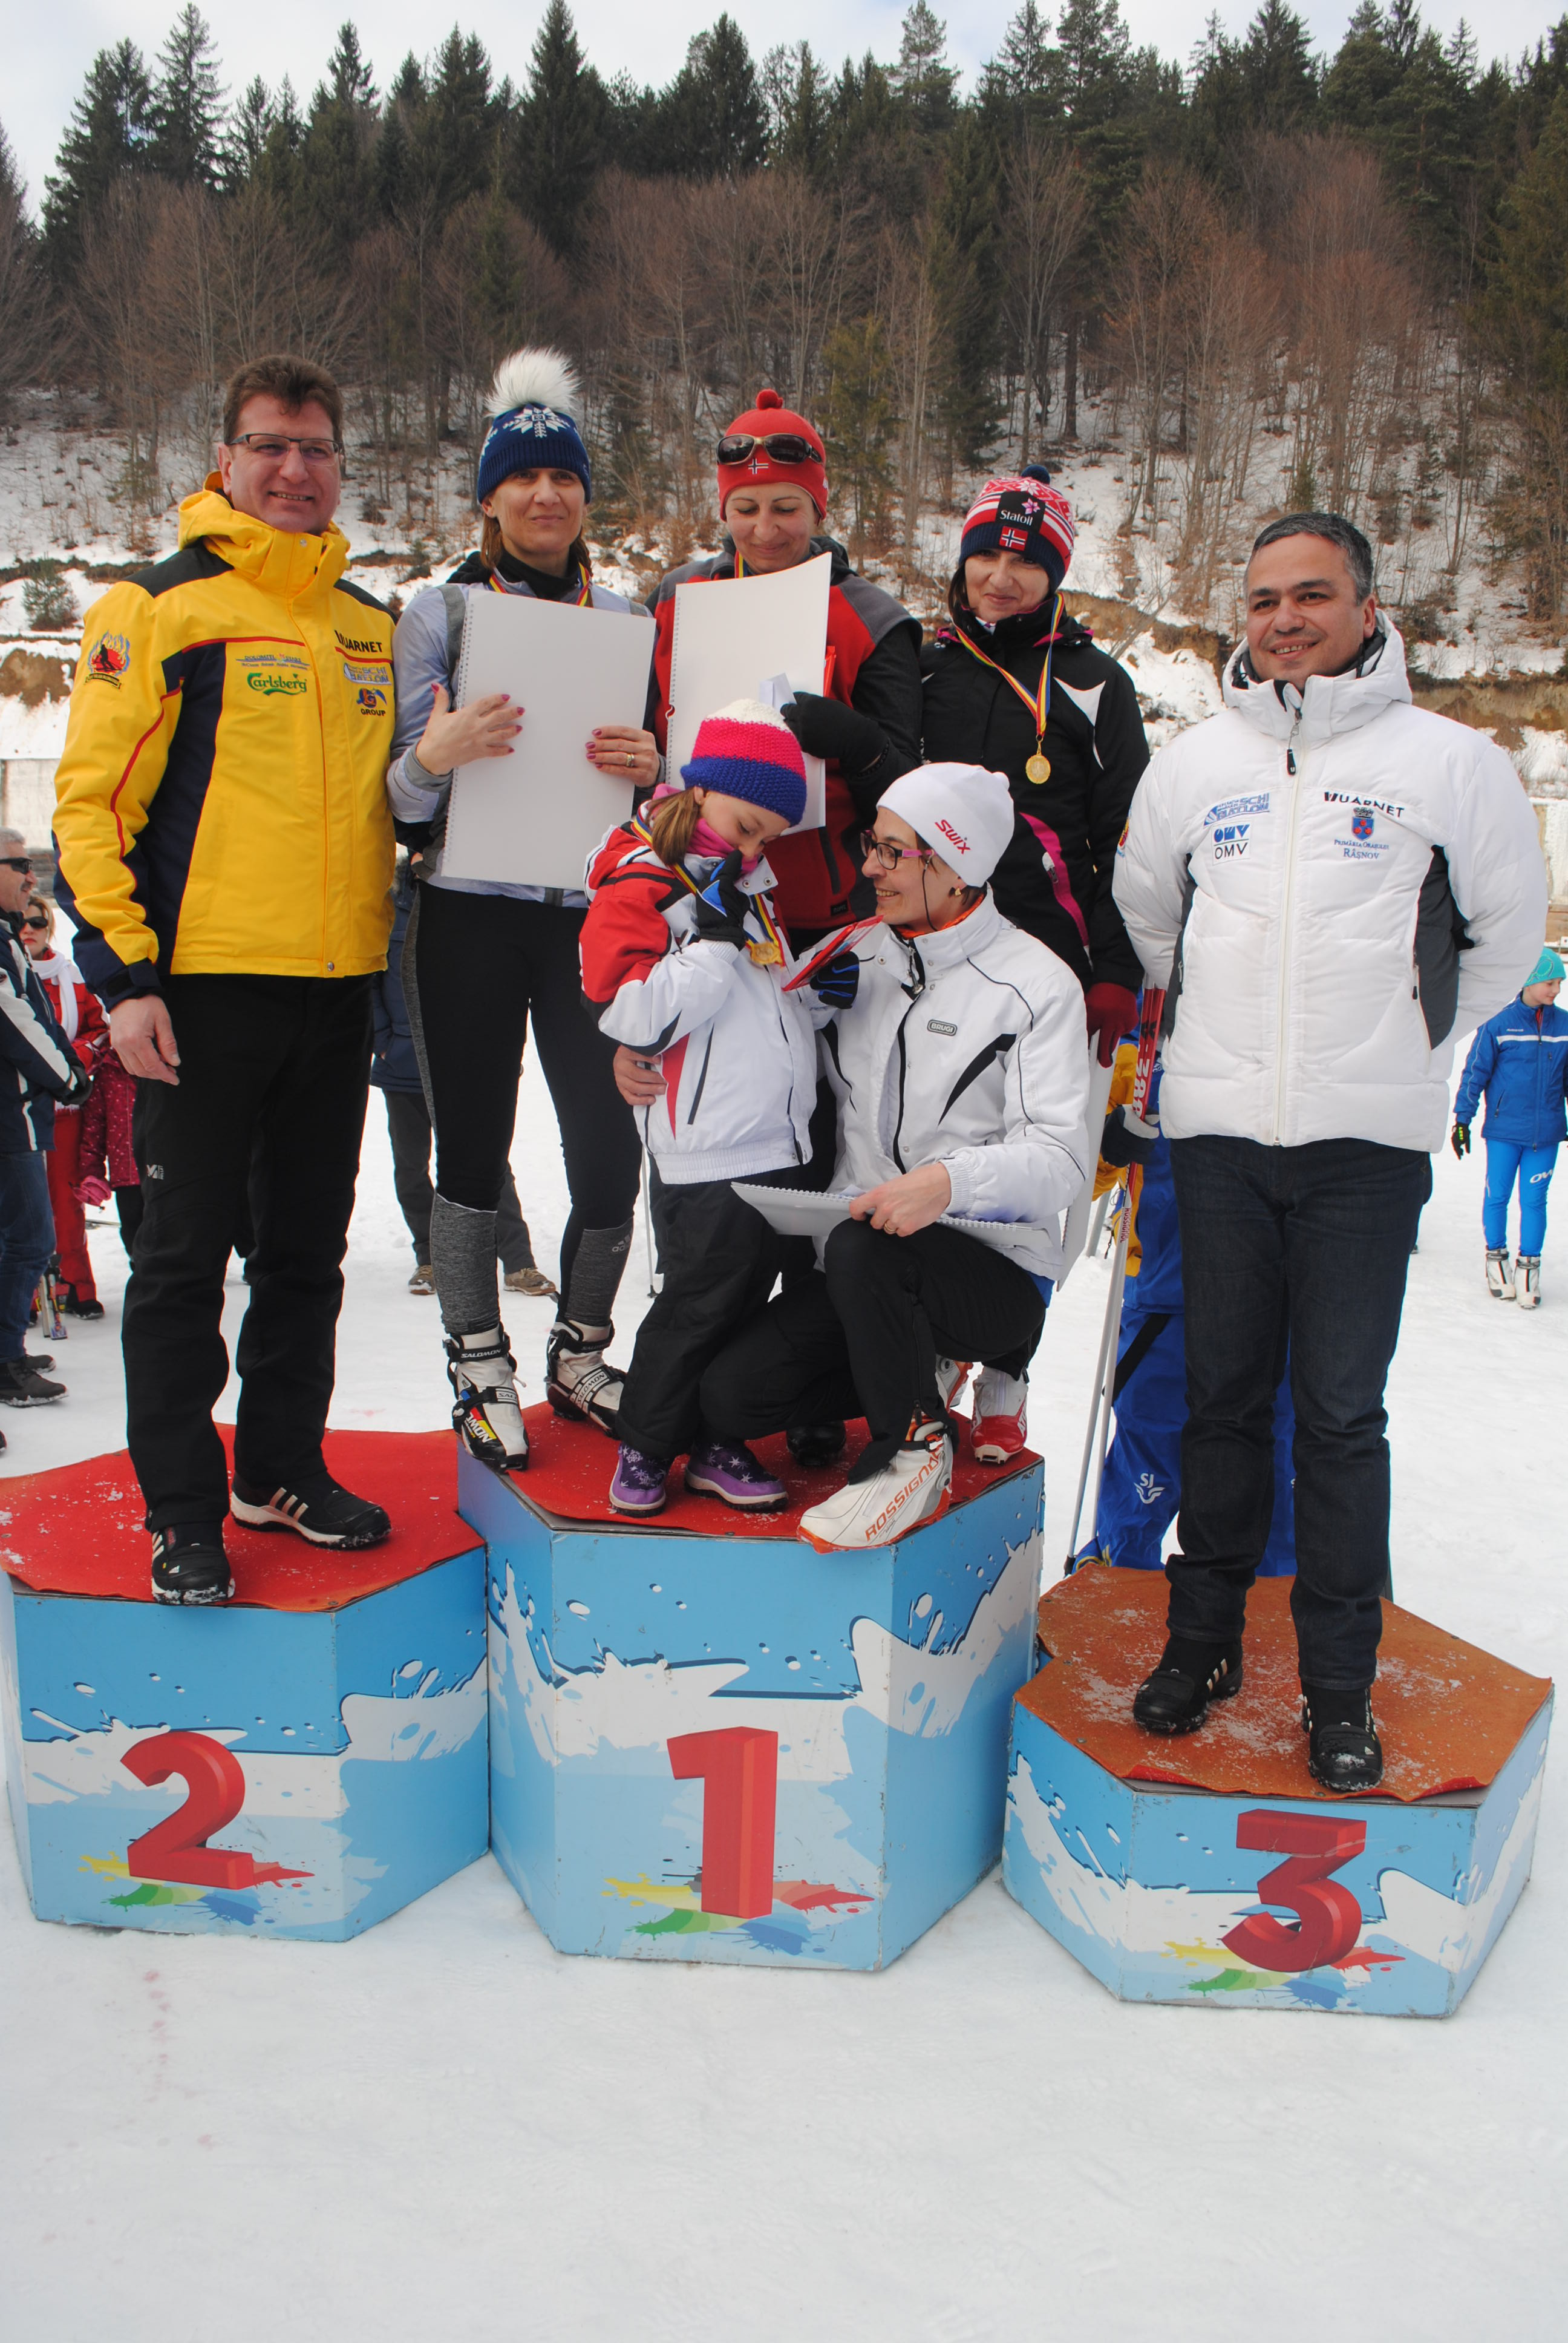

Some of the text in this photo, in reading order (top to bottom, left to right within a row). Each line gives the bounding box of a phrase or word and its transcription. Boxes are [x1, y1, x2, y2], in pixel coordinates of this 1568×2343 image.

[1000, 510, 1033, 526] Statoil
[247, 672, 307, 696] Carlsberg
[1240, 793, 1269, 806] SCHI
[1215, 842, 1248, 859] OMV
[930, 1023, 954, 1033] BRUGI
[460, 1348, 501, 1358] SALOMON
[577, 1372, 605, 1404] SALOMON
[1140, 1473, 1154, 1488] SJ
[120, 1731, 253, 1890] 2
[667, 1726, 779, 1919] 1
[1221, 1808, 1367, 1973] 3
